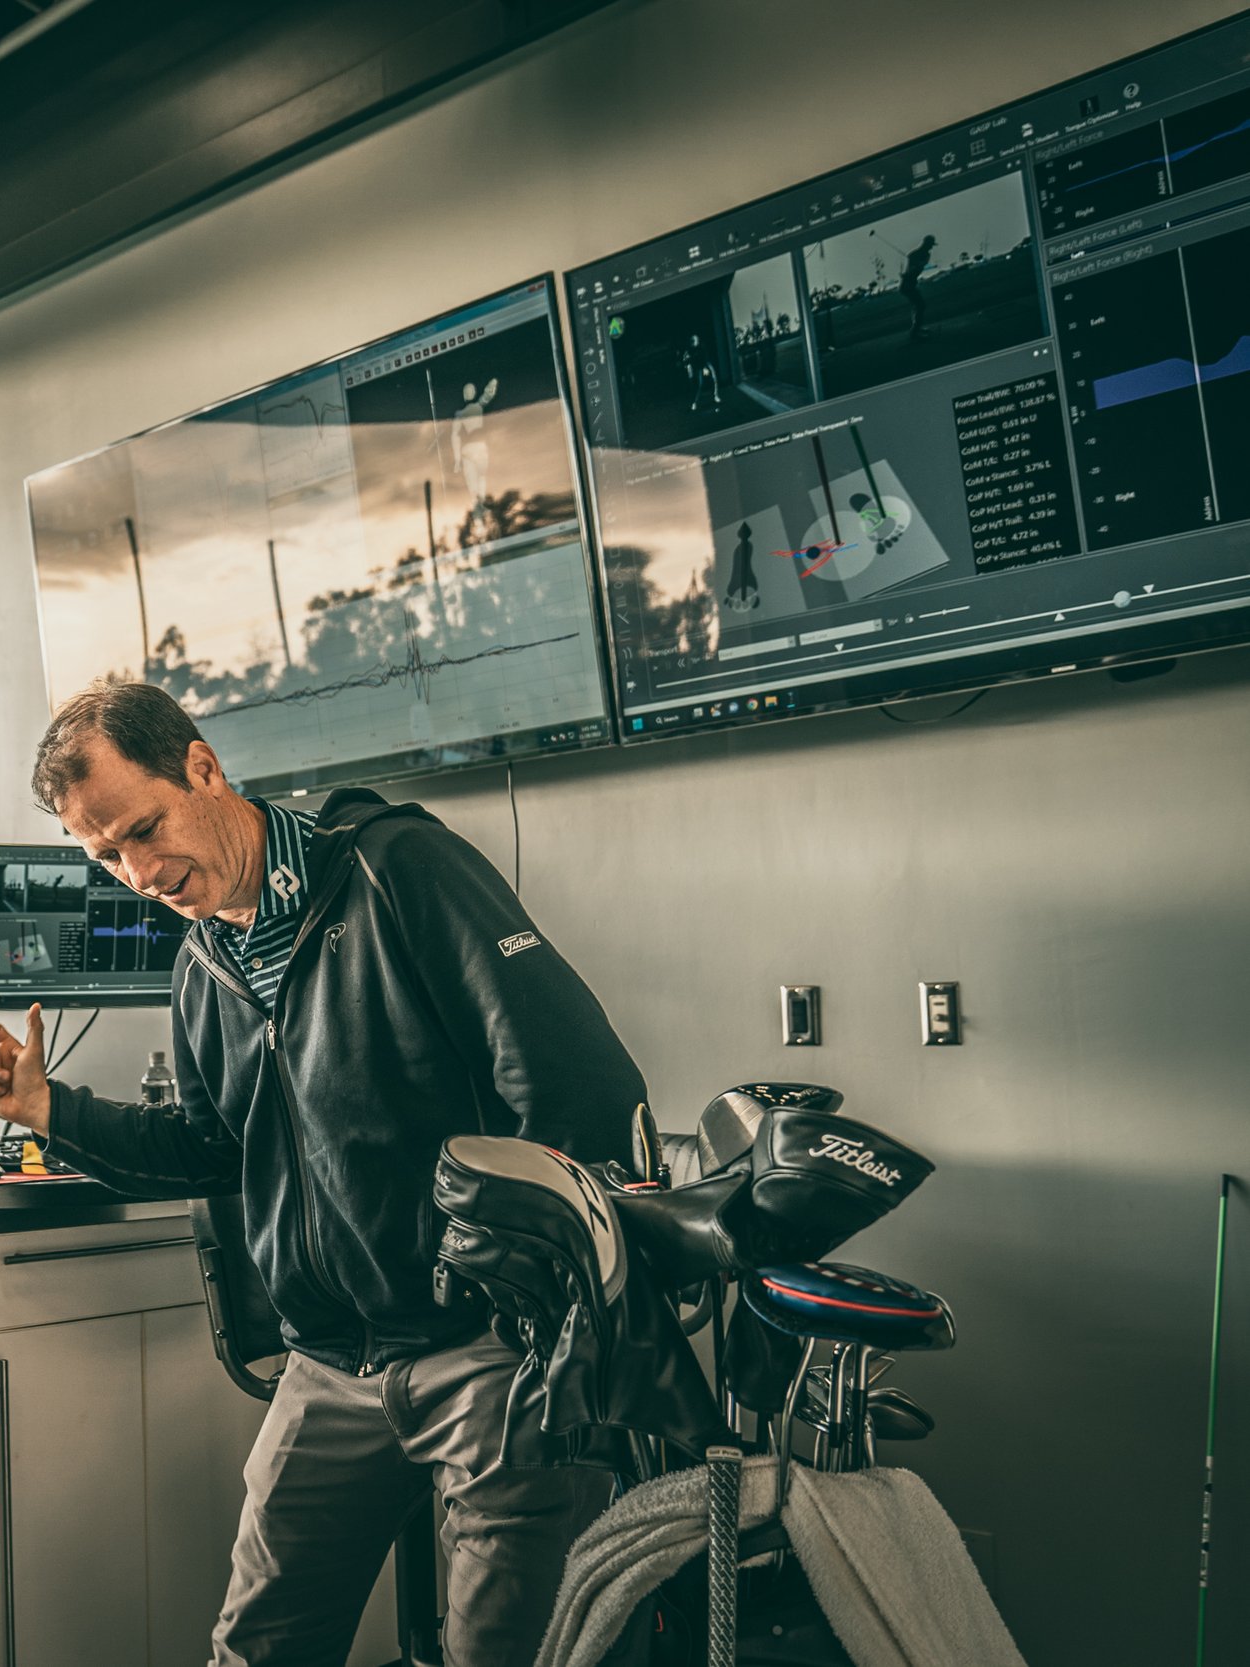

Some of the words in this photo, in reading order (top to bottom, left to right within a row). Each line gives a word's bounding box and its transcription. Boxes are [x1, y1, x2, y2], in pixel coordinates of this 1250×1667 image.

[1049, 232, 1094, 256] Right/Left
[1094, 226, 1118, 242] Force
[1119, 219, 1142, 236] (Left)
[1053, 261, 1095, 282] Right/Left
[1097, 253, 1122, 268] Force
[1122, 245, 1152, 262] (Right)
[955, 399, 976, 409] Force
[957, 415, 978, 425] Force
[269, 864, 300, 900] FJ
[504, 936, 537, 954] Titleist
[808, 1134, 901, 1186] Titleist
